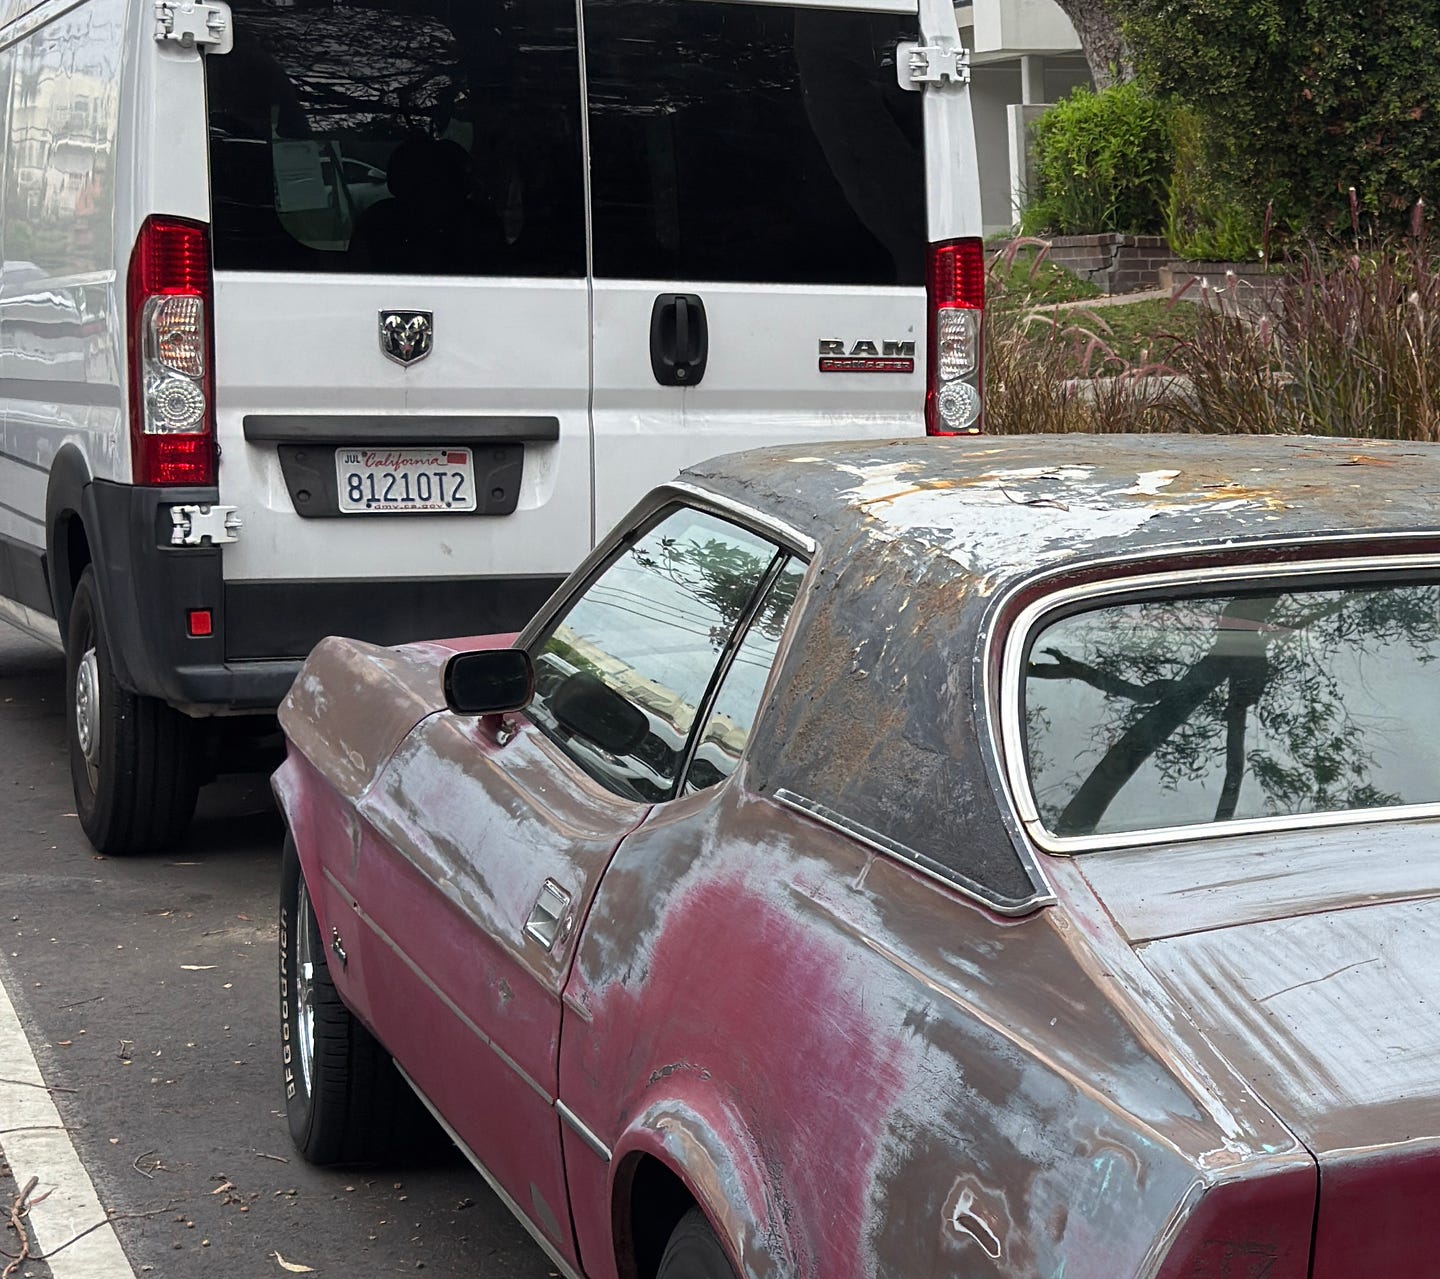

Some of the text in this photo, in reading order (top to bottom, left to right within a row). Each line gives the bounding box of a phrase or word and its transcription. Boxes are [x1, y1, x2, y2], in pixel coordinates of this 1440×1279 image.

[818, 338, 915, 356] RAM
[344, 452, 448, 472] JUL California
[347, 472, 467, 503] 81210T2
[280, 908, 296, 1099] BFGoodrich
